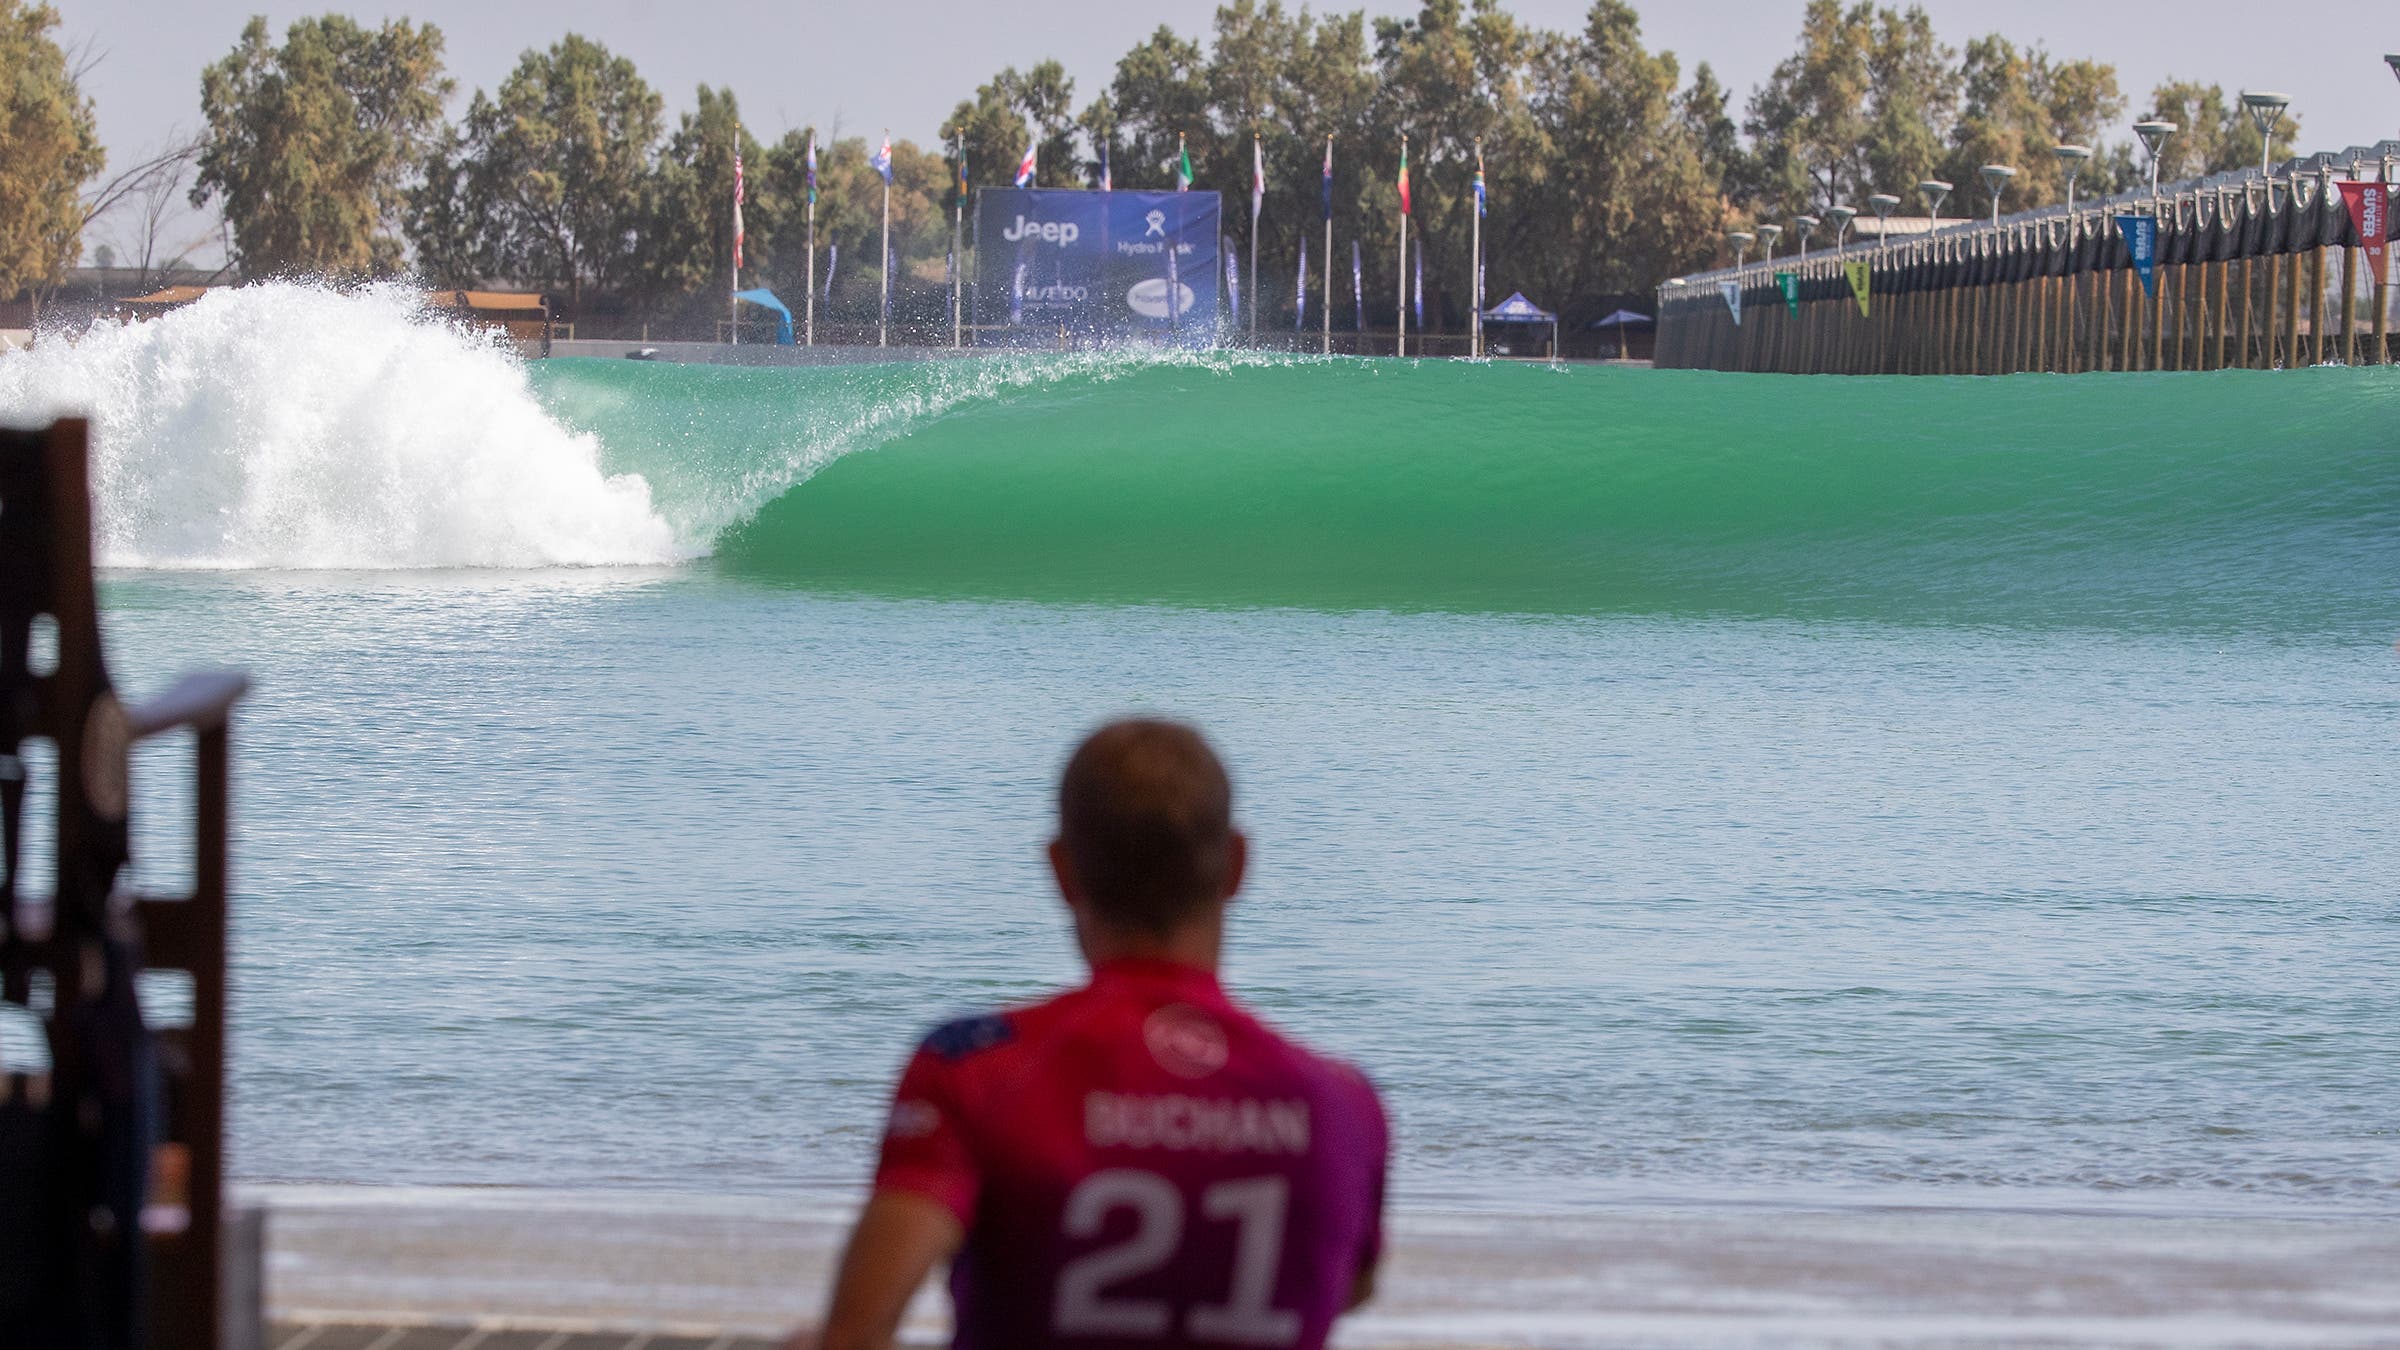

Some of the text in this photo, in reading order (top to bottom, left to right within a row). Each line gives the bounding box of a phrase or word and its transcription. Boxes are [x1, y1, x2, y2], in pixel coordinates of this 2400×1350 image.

[1003, 215, 1079, 247] Jeep
[2363, 188, 2376, 237] SURFER
[1117, 241, 1193, 257] Hydro Fsk
[1083, 1092, 1309, 1153] BUCHAN
[1052, 1168, 1301, 1343] 21
